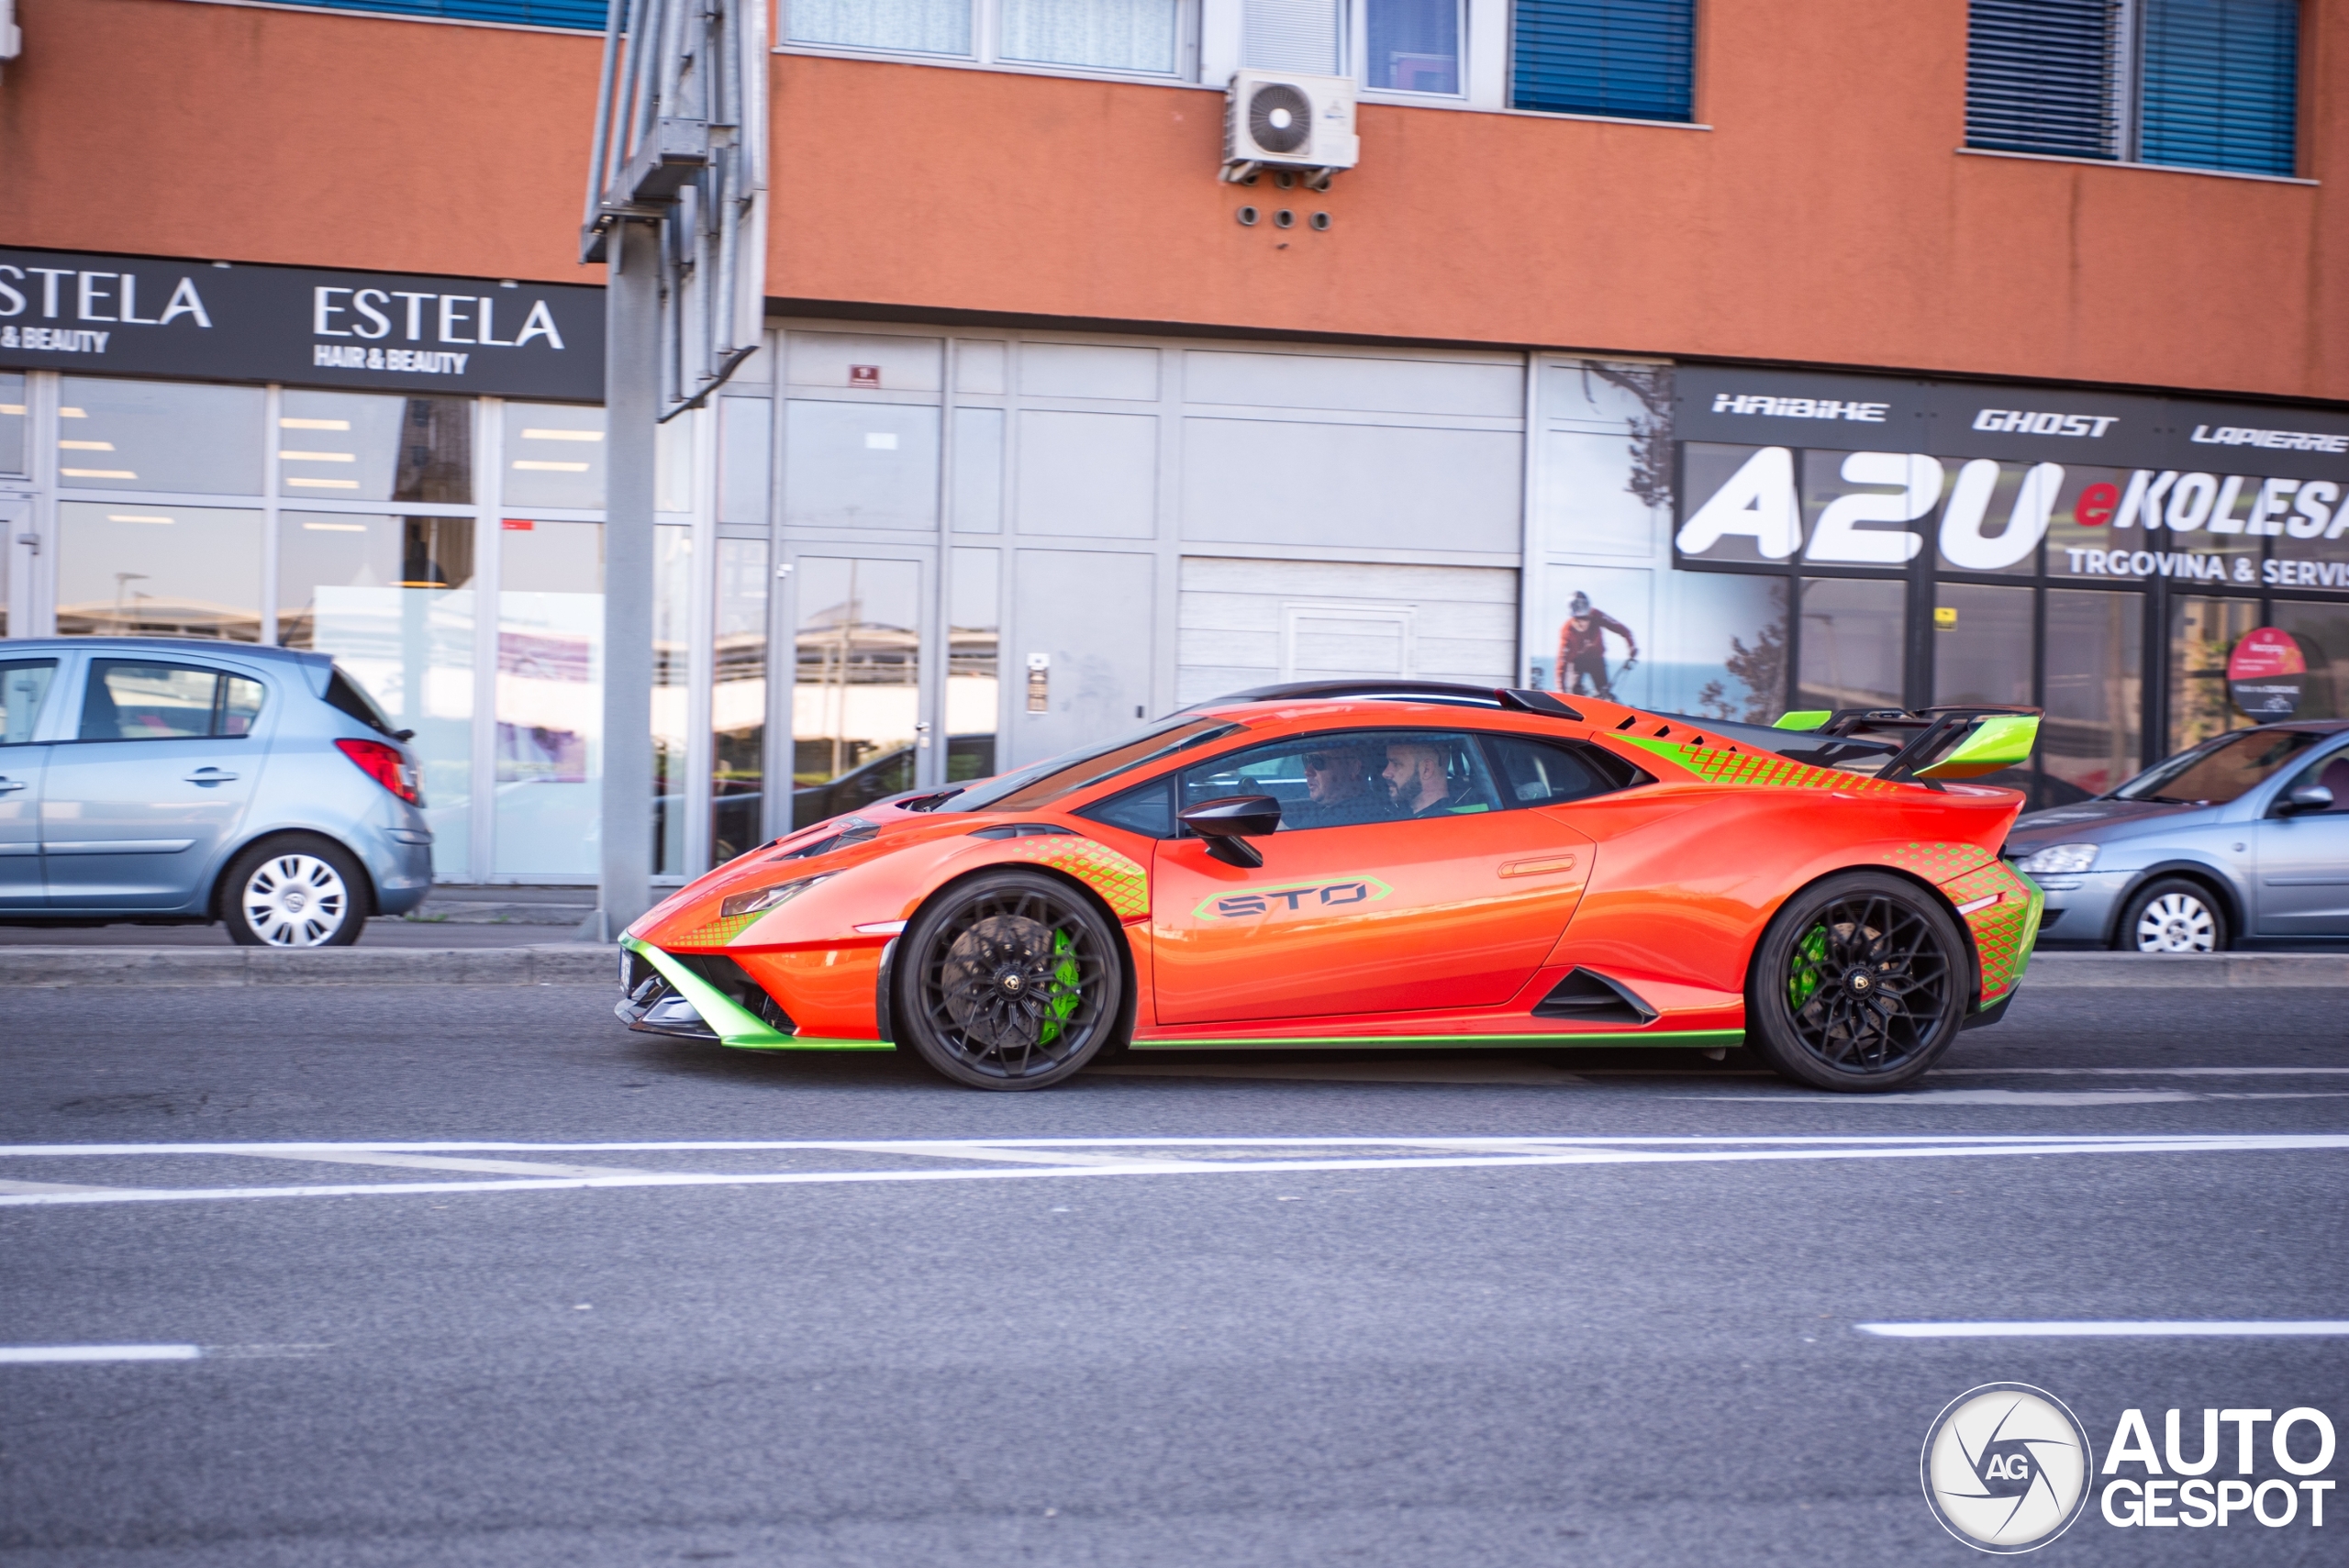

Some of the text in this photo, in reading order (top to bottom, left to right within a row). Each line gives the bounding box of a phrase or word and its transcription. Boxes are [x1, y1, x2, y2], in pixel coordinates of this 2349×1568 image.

[314, 286, 565, 350] ESTELA
[1972, 408, 2121, 438] GHOST
[2190, 425, 2349, 453] LAPIERRE
[1675, 446, 2065, 570] A2U
[2065, 548, 2349, 586] TRGOVINA & SERVI
[1219, 883, 1367, 917] STO
